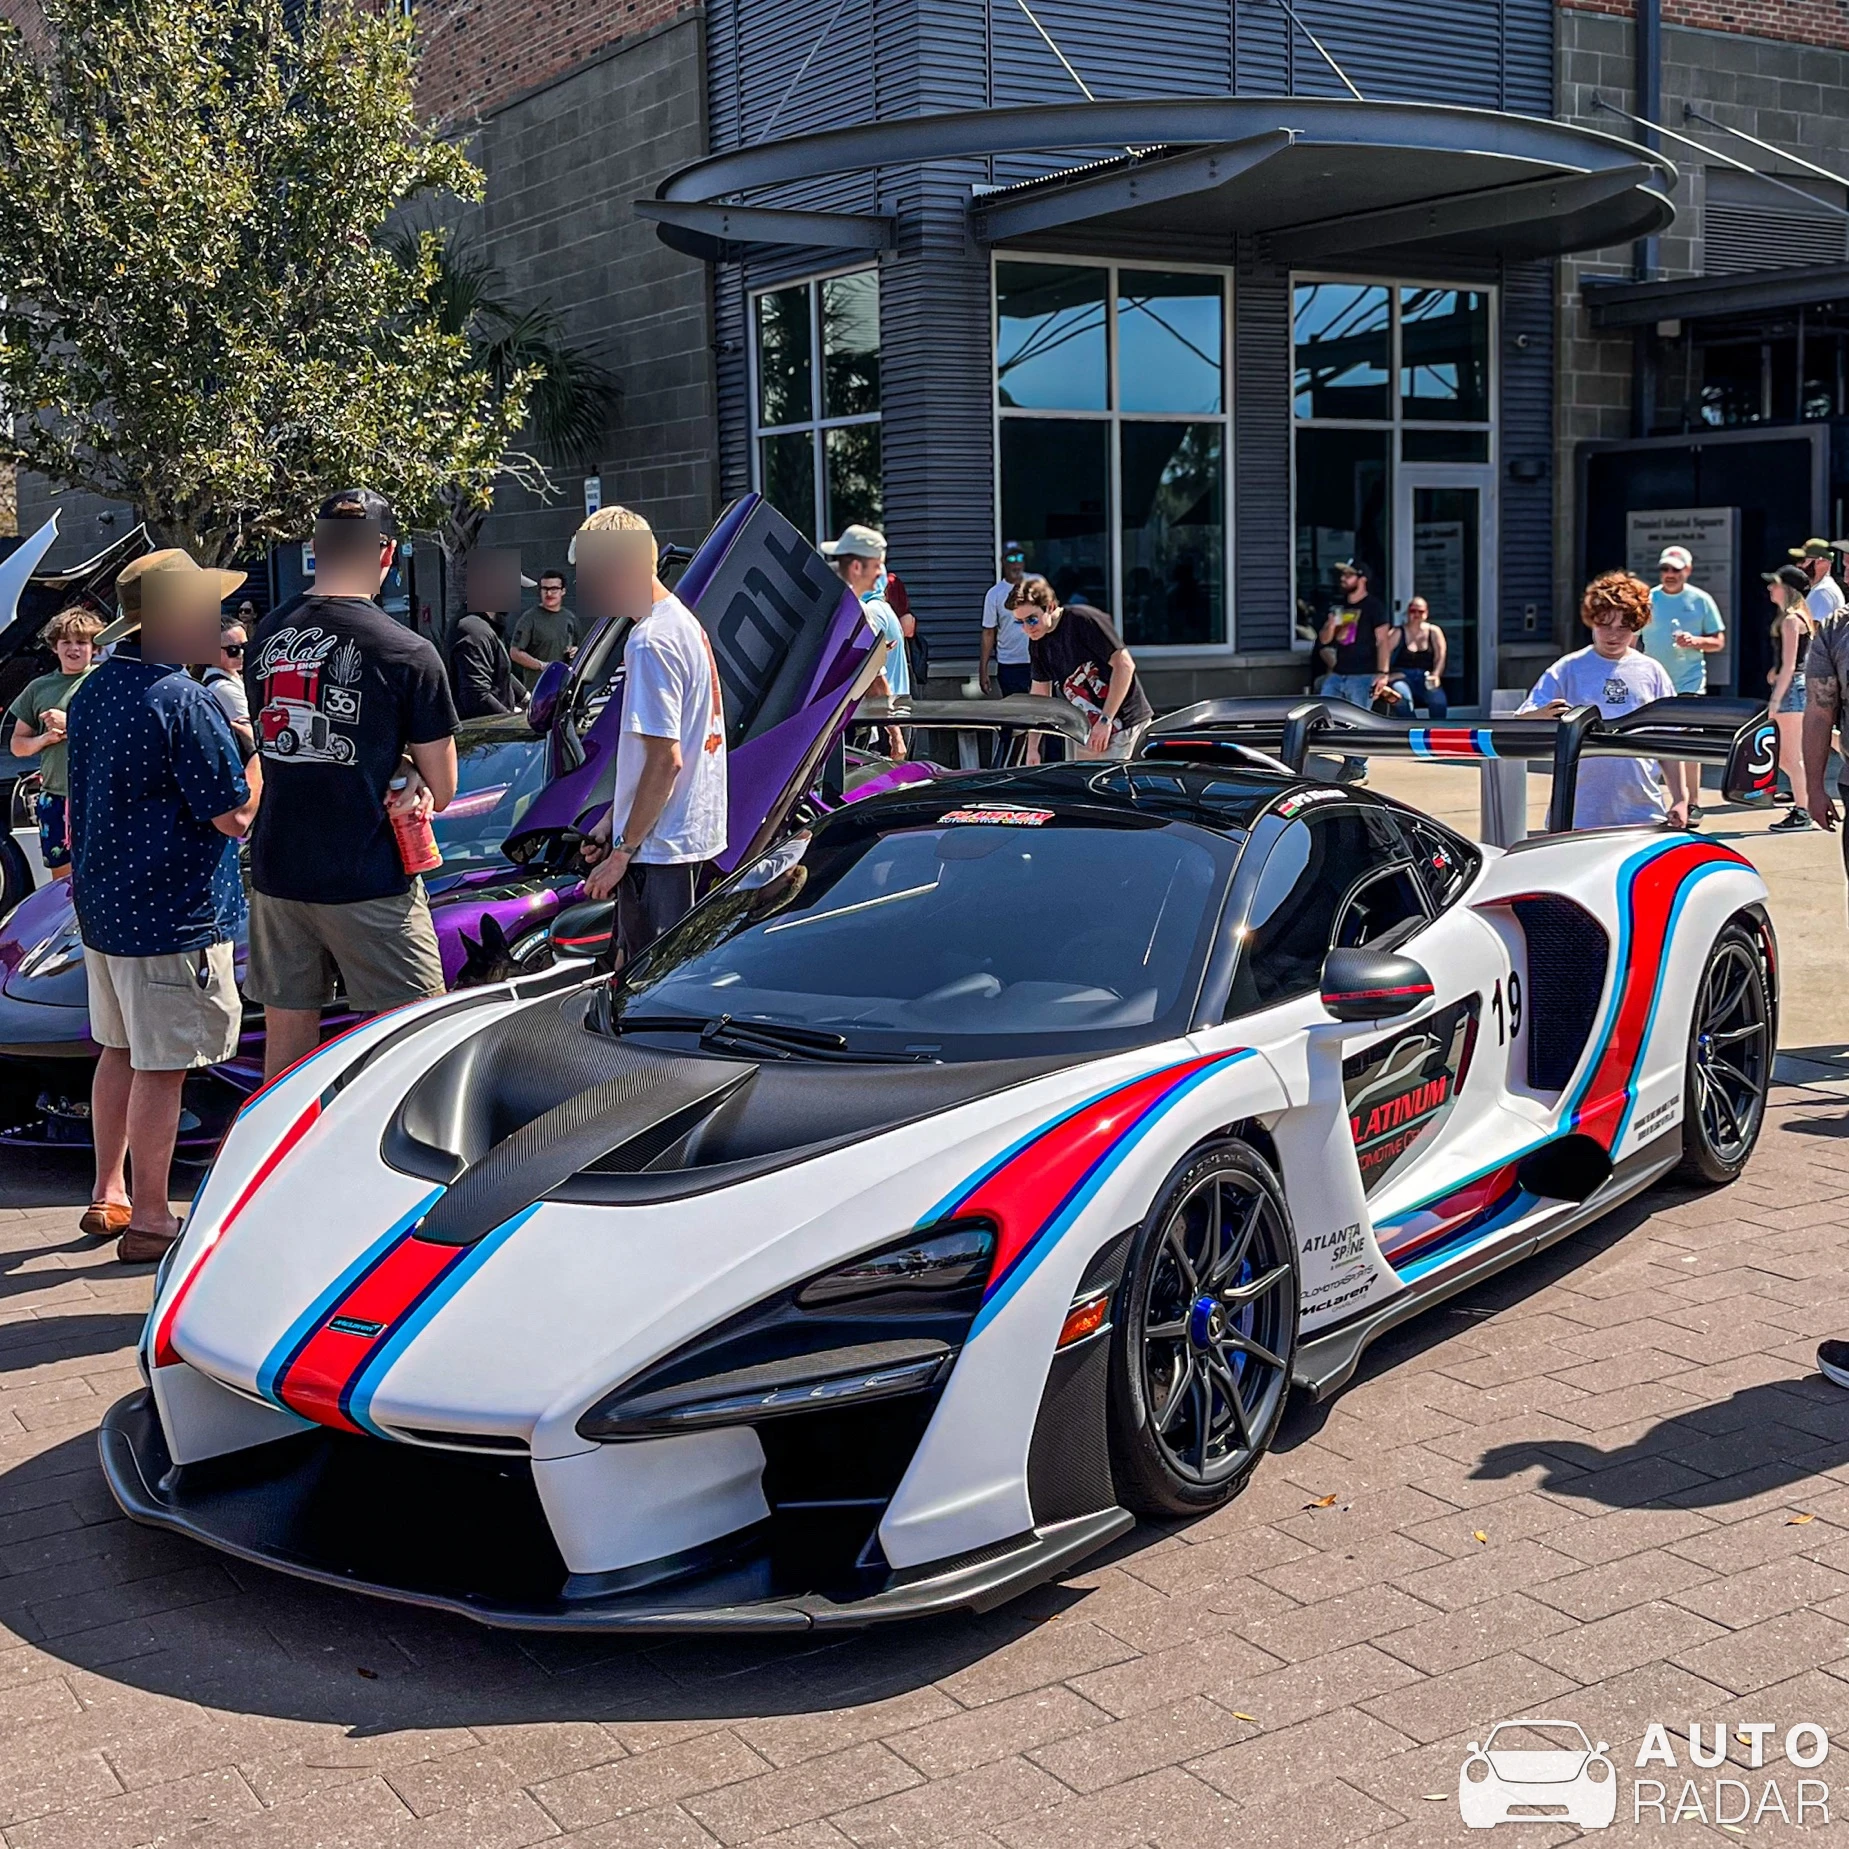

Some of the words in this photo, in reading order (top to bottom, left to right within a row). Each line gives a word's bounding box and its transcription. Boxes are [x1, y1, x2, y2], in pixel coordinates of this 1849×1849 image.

[296, 661, 322, 670] SHOP
[512, 931, 545, 960] CHELIN
[1491, 970, 1522, 1047] 19
[1349, 1074, 1448, 1145] LATINUM
[1301, 1222, 1361, 1254] ATLANTA
[1330, 1237, 1365, 1263] SPINE
